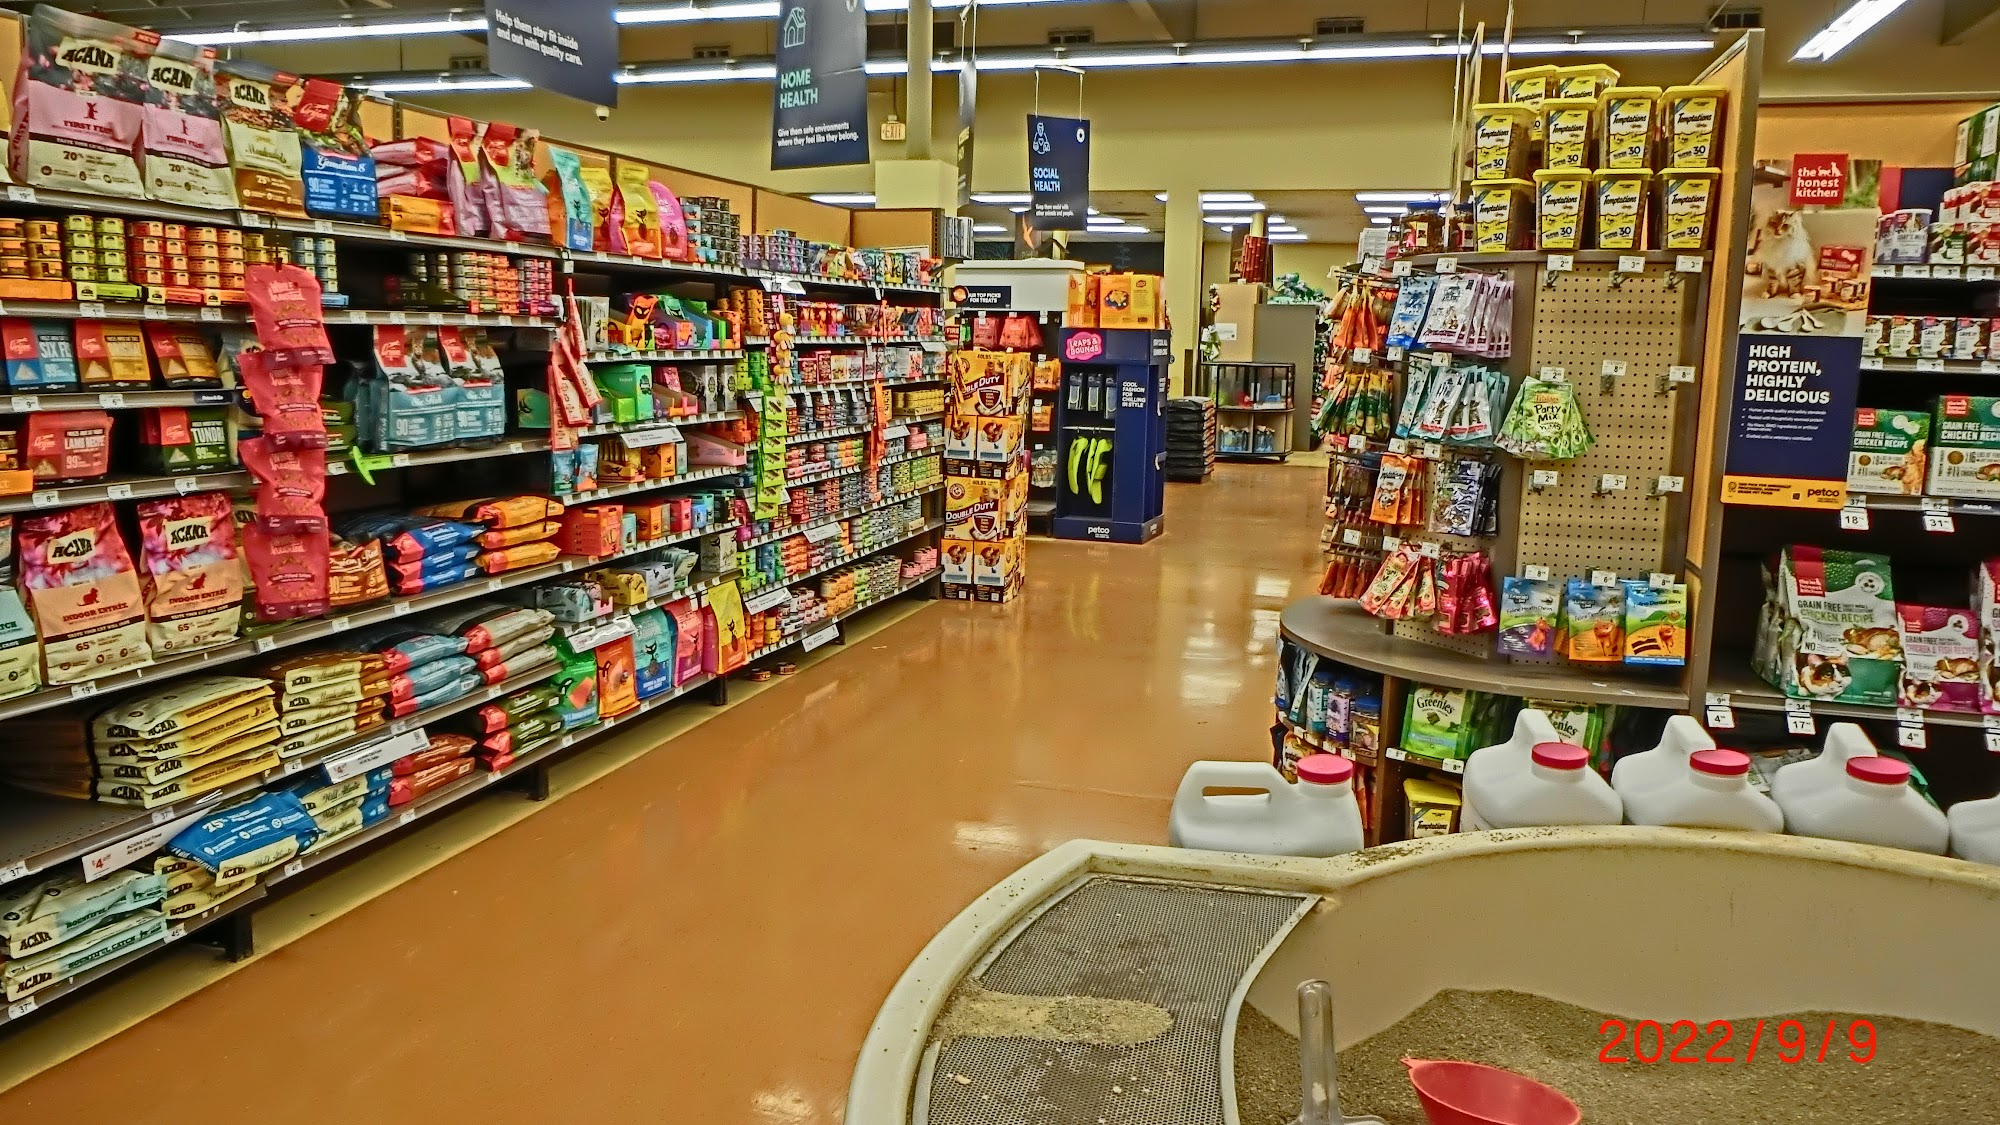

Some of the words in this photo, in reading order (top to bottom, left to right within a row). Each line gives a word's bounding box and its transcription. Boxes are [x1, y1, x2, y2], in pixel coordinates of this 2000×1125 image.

[496, 9, 513, 28] Help
[514, 17, 532, 34] them
[533, 26, 548, 42] stay
[548, 29, 558, 43] fit
[558, 33, 579, 51] inside
[497, 27, 511, 41] and
[511, 33, 525, 46] out
[524, 38, 540, 52] with
[540, 43, 565, 62] quality
[565, 52, 583, 66] care.
[61, 46, 115, 69] ACANA
[780, 68, 811, 89] HOME
[234, 84, 266, 105] ACANA
[779, 87, 819, 109] HEALTH
[1515, 92, 1543, 103] Temptations
[1563, 90, 1593, 99] Temptations
[1612, 113, 1647, 126] Temptations
[1677, 112, 1712, 124] Temptations
[777, 128, 790, 138] Give
[790, 126, 803, 136] them
[803, 124, 815, 134] safe
[815, 121, 850, 133] environments
[1480, 128, 1509, 139] Temptations
[1552, 123, 1585, 134] Temptations
[777, 137, 793, 147] where
[793, 136, 806, 147] they
[805, 135, 816, 145] feel
[816, 134, 826, 144] like
[826, 132, 839, 144] they
[838, 131, 859, 142] belong.
[1628, 146, 1641, 155] 30
[1693, 145, 1706, 155] 30
[1493, 158, 1504, 167] 30
[1567, 154, 1579, 163] 30
[1033, 167, 1059, 179] SOCIAL
[1798, 166, 1816, 177] the
[1034, 180, 1061, 192] HEALTH
[1796, 177, 1840, 189] honest
[1795, 187, 1839, 198] kitchen
[1544, 194, 1577, 207] Temptations
[1603, 194, 1637, 206] Temptations
[1671, 193, 1706, 205] Temptations
[1479, 203, 1507, 214] Temptations
[1493, 232, 1504, 241] 30
[1560, 226, 1572, 236] 30
[1619, 226, 1631, 236] 30
[1687, 226, 1700, 236] 30
[1749, 344, 1791, 358] HIGH
[1747, 359, 1822, 377] PROTEIN,
[979, 375, 1001, 387] DUTY
[1746, 374, 1806, 389] HIGHLY
[1744, 388, 1830, 405] DELICIOUS
[1533, 405, 1562, 416] Party
[1537, 411, 1559, 422] Mix
[1941, 430, 1979, 441] CHICKEN
[1853, 438, 1883, 447] CHICKEN
[1884, 440, 1909, 449] RECIPE
[1807, 487, 1840, 498] petco
[946, 507, 974, 521] DOUBLE
[974, 501, 995, 513] DUTY
[169, 524, 209, 545] ACANA
[1087, 525, 1111, 535] petco
[51, 537, 93, 559] ACANA
[169, 593, 201, 605] INDOOR
[1797, 600, 1822, 610] GRAIN
[1824, 601, 1841, 613] FREE
[63, 608, 97, 623] INDOOR
[1800, 608, 1838, 622] CHICKEN
[1841, 613, 1875, 624] RECIPE
[1804, 641, 1816, 652] NO
[1416, 695, 1456, 715] Greenies
[148, 719, 178, 736] ACANA
[1552, 720, 1578, 736] enies
[153, 759, 183, 777] ACANA
[151, 782, 181, 800] ACANA
[1416, 819, 1448, 831] Temptations
[19, 930, 53, 951] ACANA
[16, 971, 53, 994] ACANA
